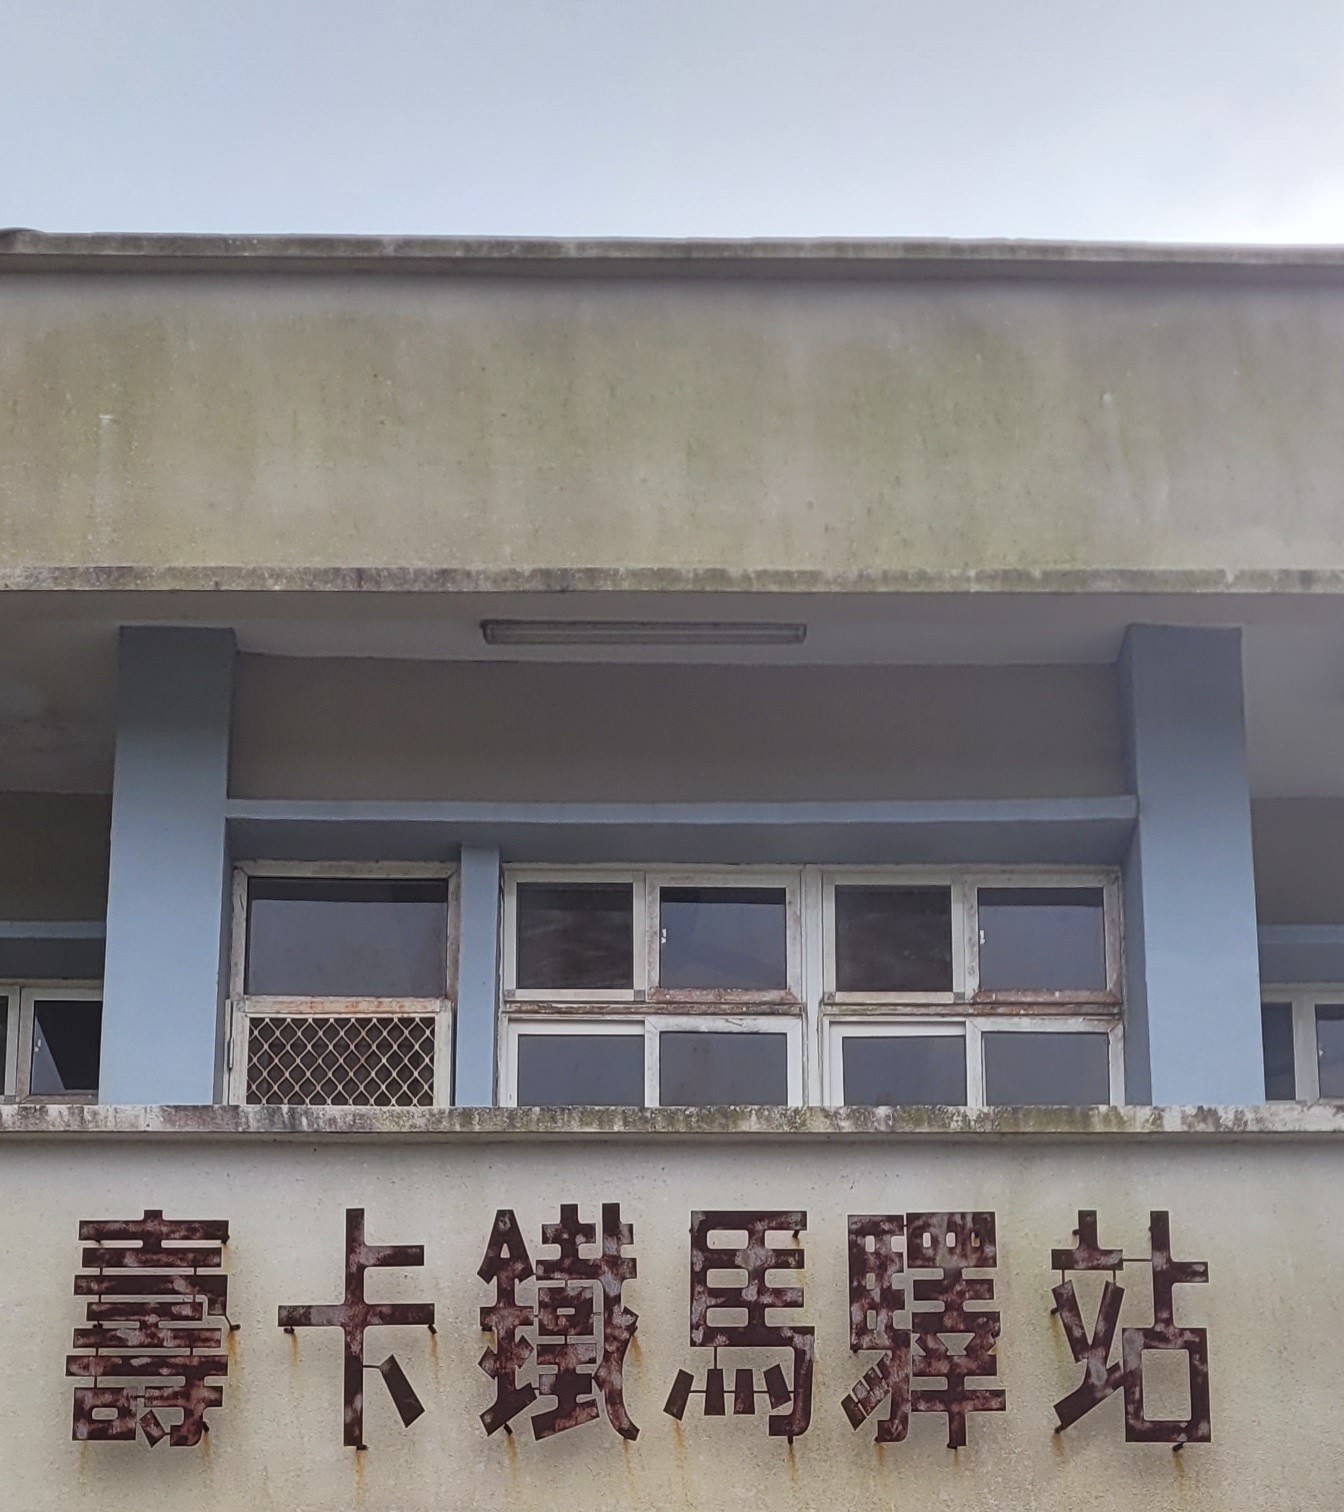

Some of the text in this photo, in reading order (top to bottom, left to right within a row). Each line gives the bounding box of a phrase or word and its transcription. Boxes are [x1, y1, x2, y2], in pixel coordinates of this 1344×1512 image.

[64, 1202, 1213, 1448] 壽卡鐵馬驛站
